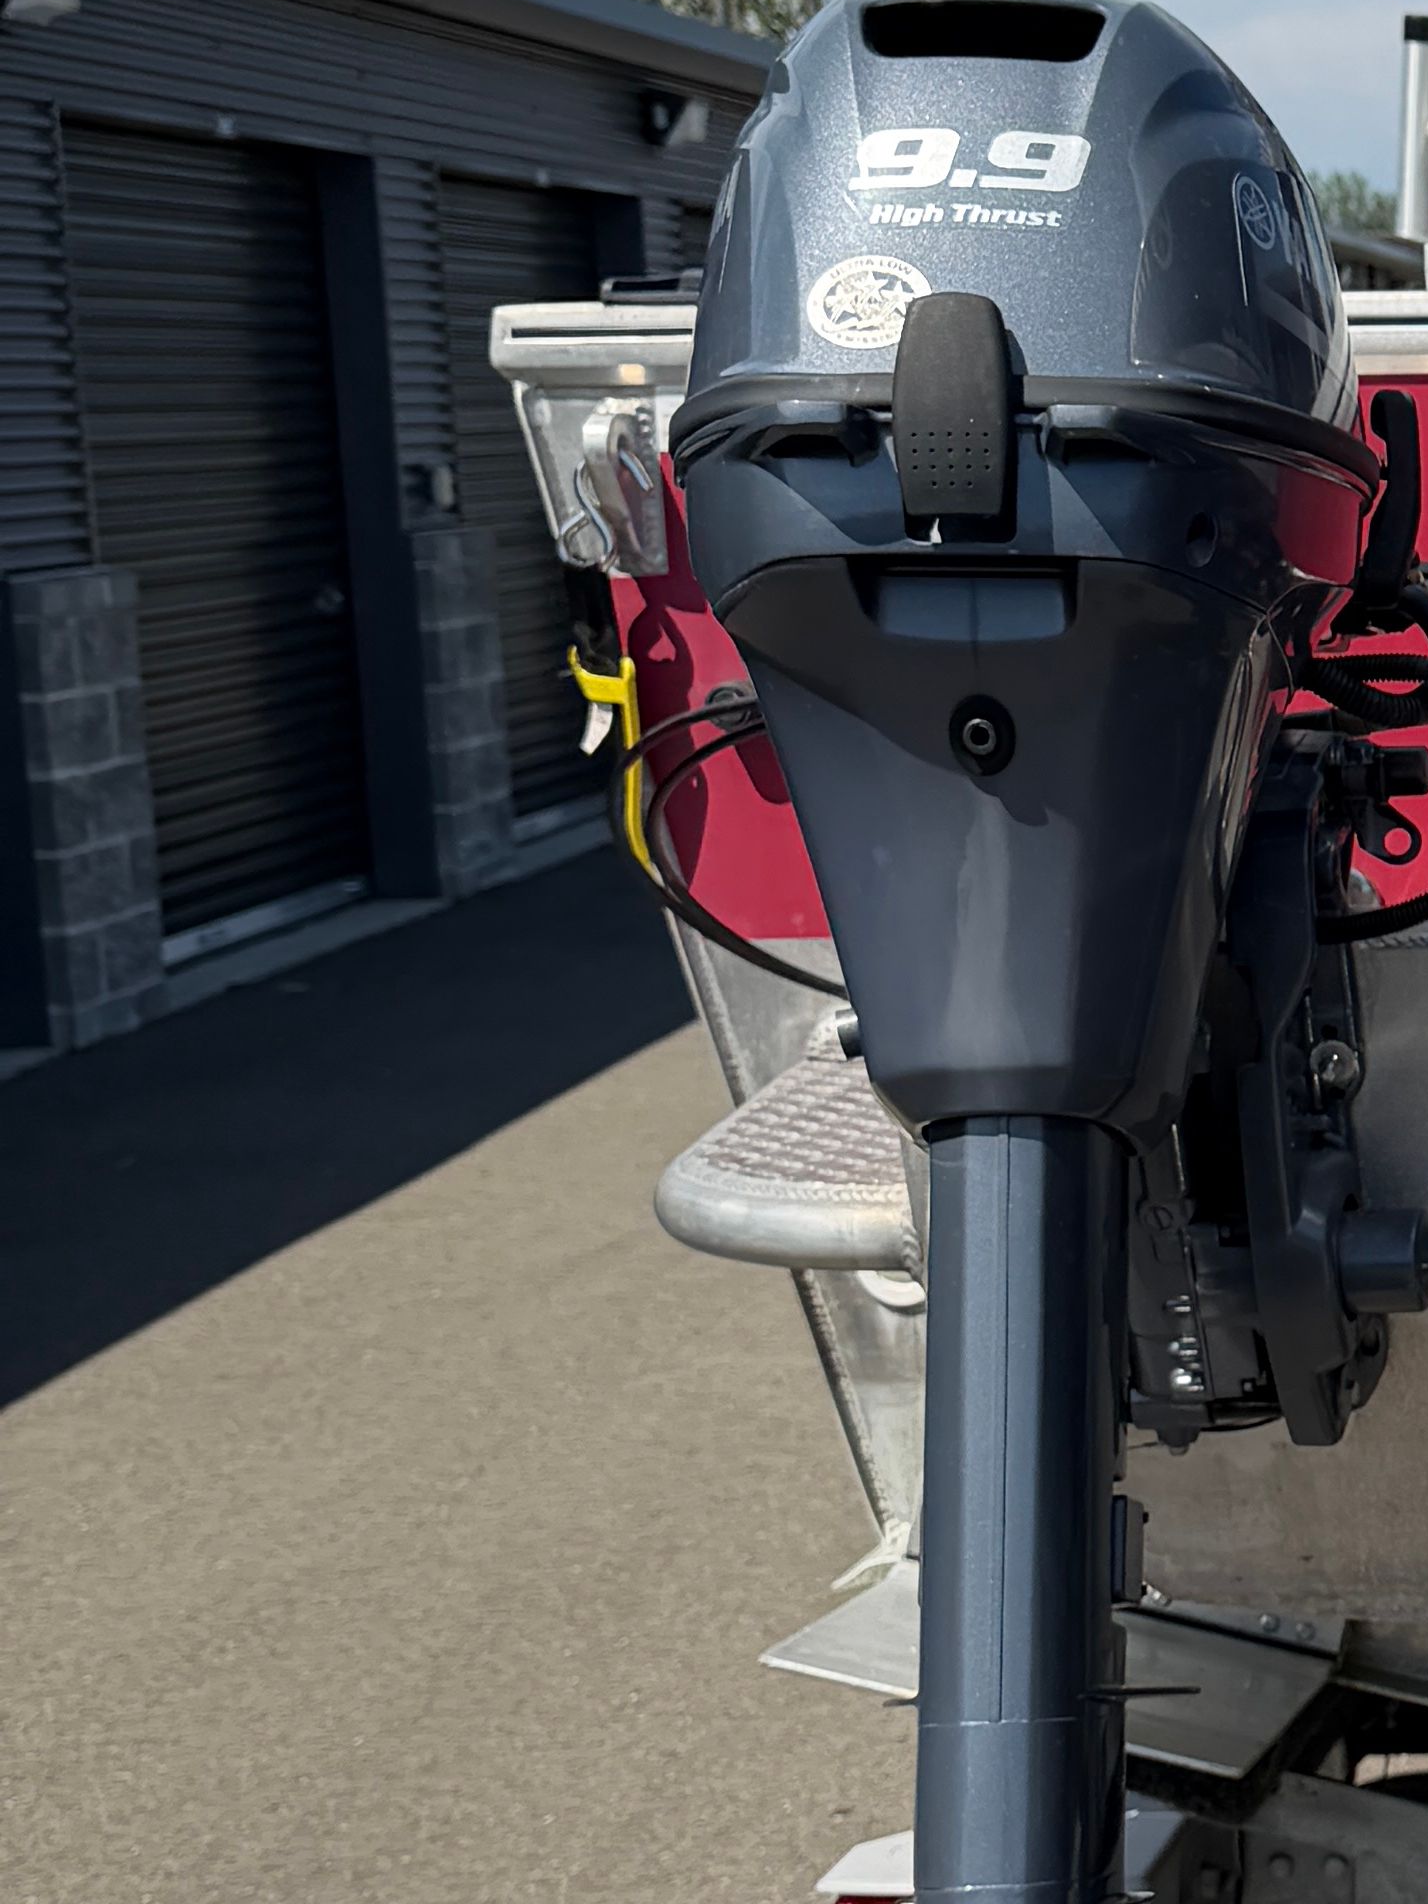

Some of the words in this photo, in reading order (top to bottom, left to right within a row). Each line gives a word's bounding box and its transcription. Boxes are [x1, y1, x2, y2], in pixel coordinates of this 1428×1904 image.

[847, 127, 1092, 193] 9.9
[868, 202, 945, 228] High
[950, 203, 1063, 228] Thrust
